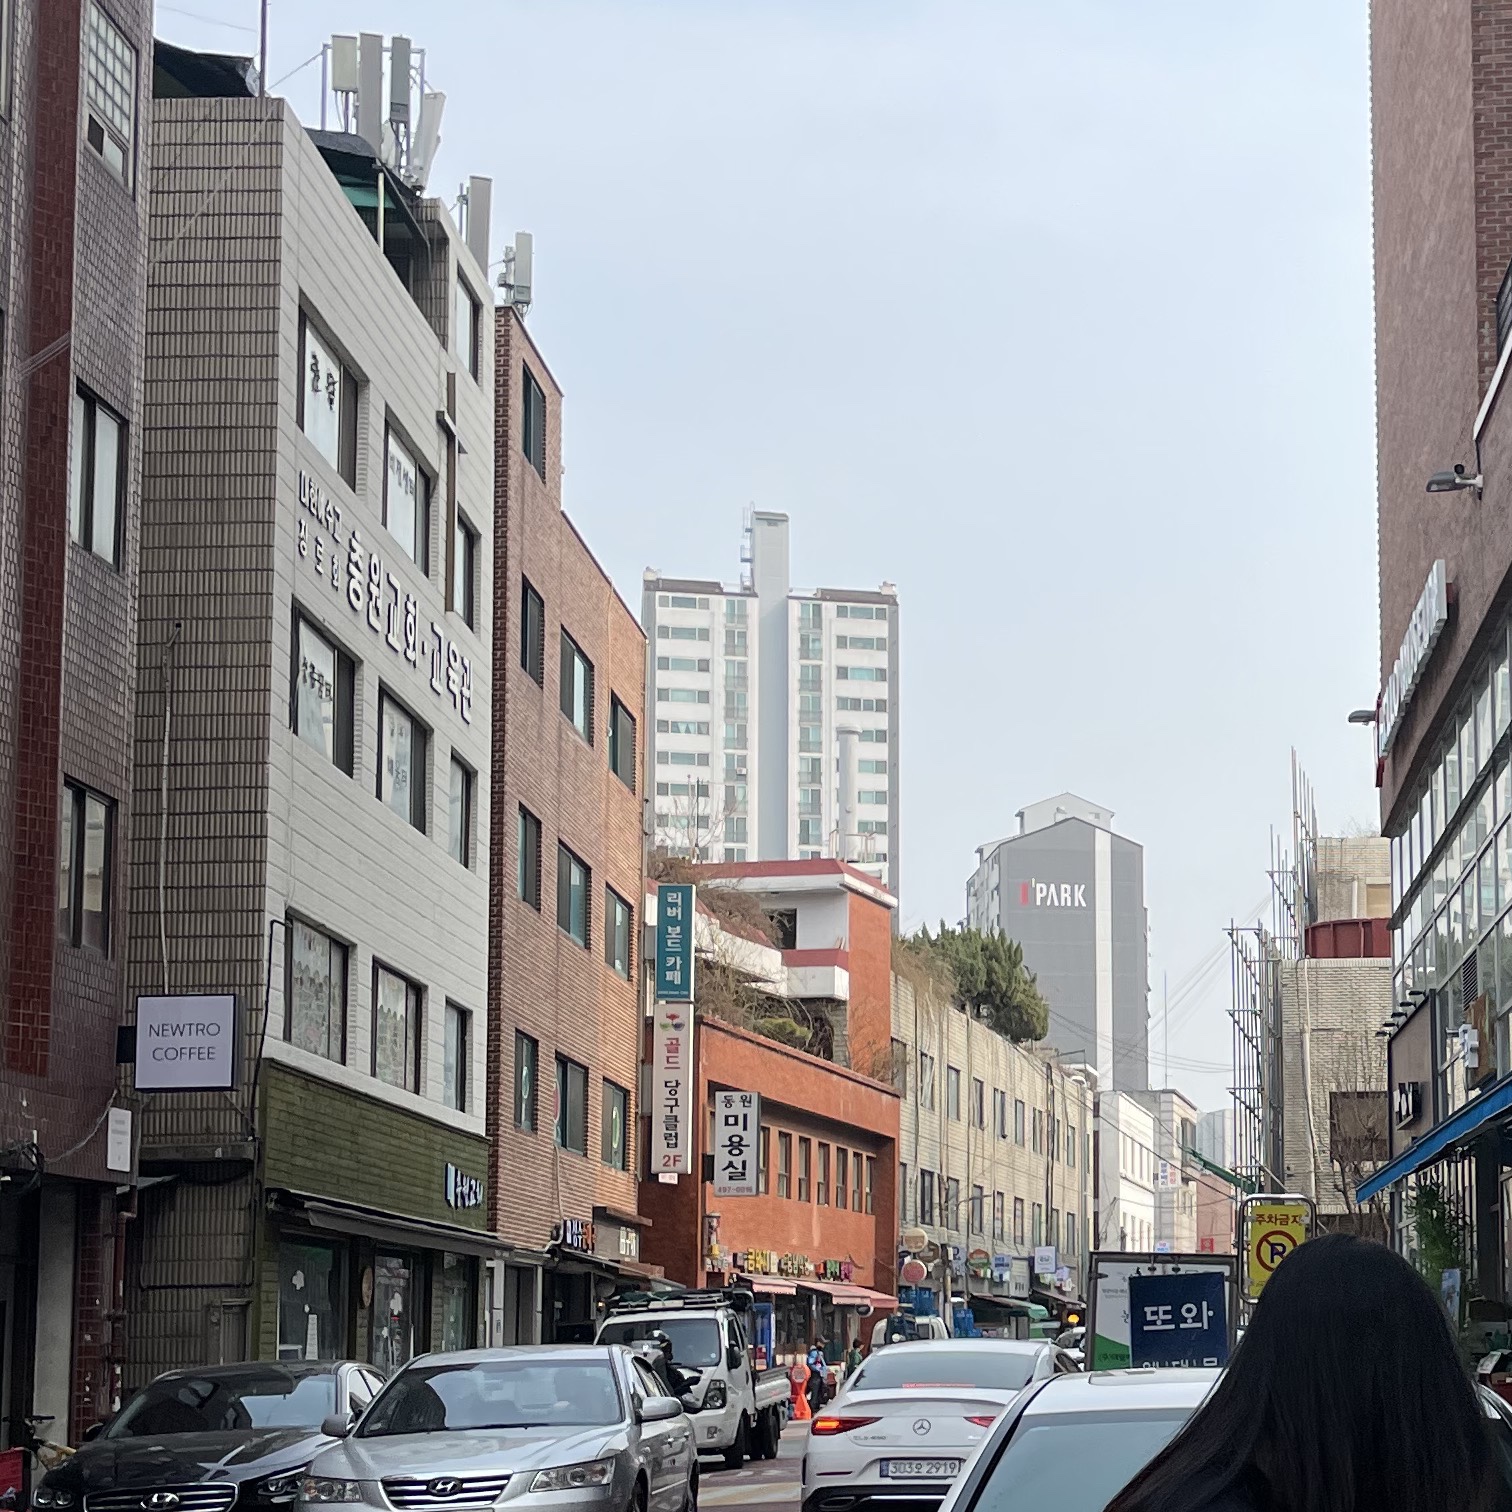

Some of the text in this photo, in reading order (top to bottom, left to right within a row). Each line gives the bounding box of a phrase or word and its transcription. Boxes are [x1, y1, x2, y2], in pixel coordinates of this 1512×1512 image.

[665, 891, 682, 921] 리버
[664, 924, 682, 952] 보드
[664, 955, 682, 985] 카페
[148, 1022, 221, 1038] NEWTRO
[152, 1046, 217, 1062] COFFEE
[663, 1037, 681, 1149] 골드 당구클럽
[720, 1094, 753, 1109] 동원
[720, 1113, 751, 1182] 미용실
[662, 1154, 683, 1168] 2F
[1255, 1213, 1303, 1227] 주차금지
[925, 1461, 958, 1475] 2919
